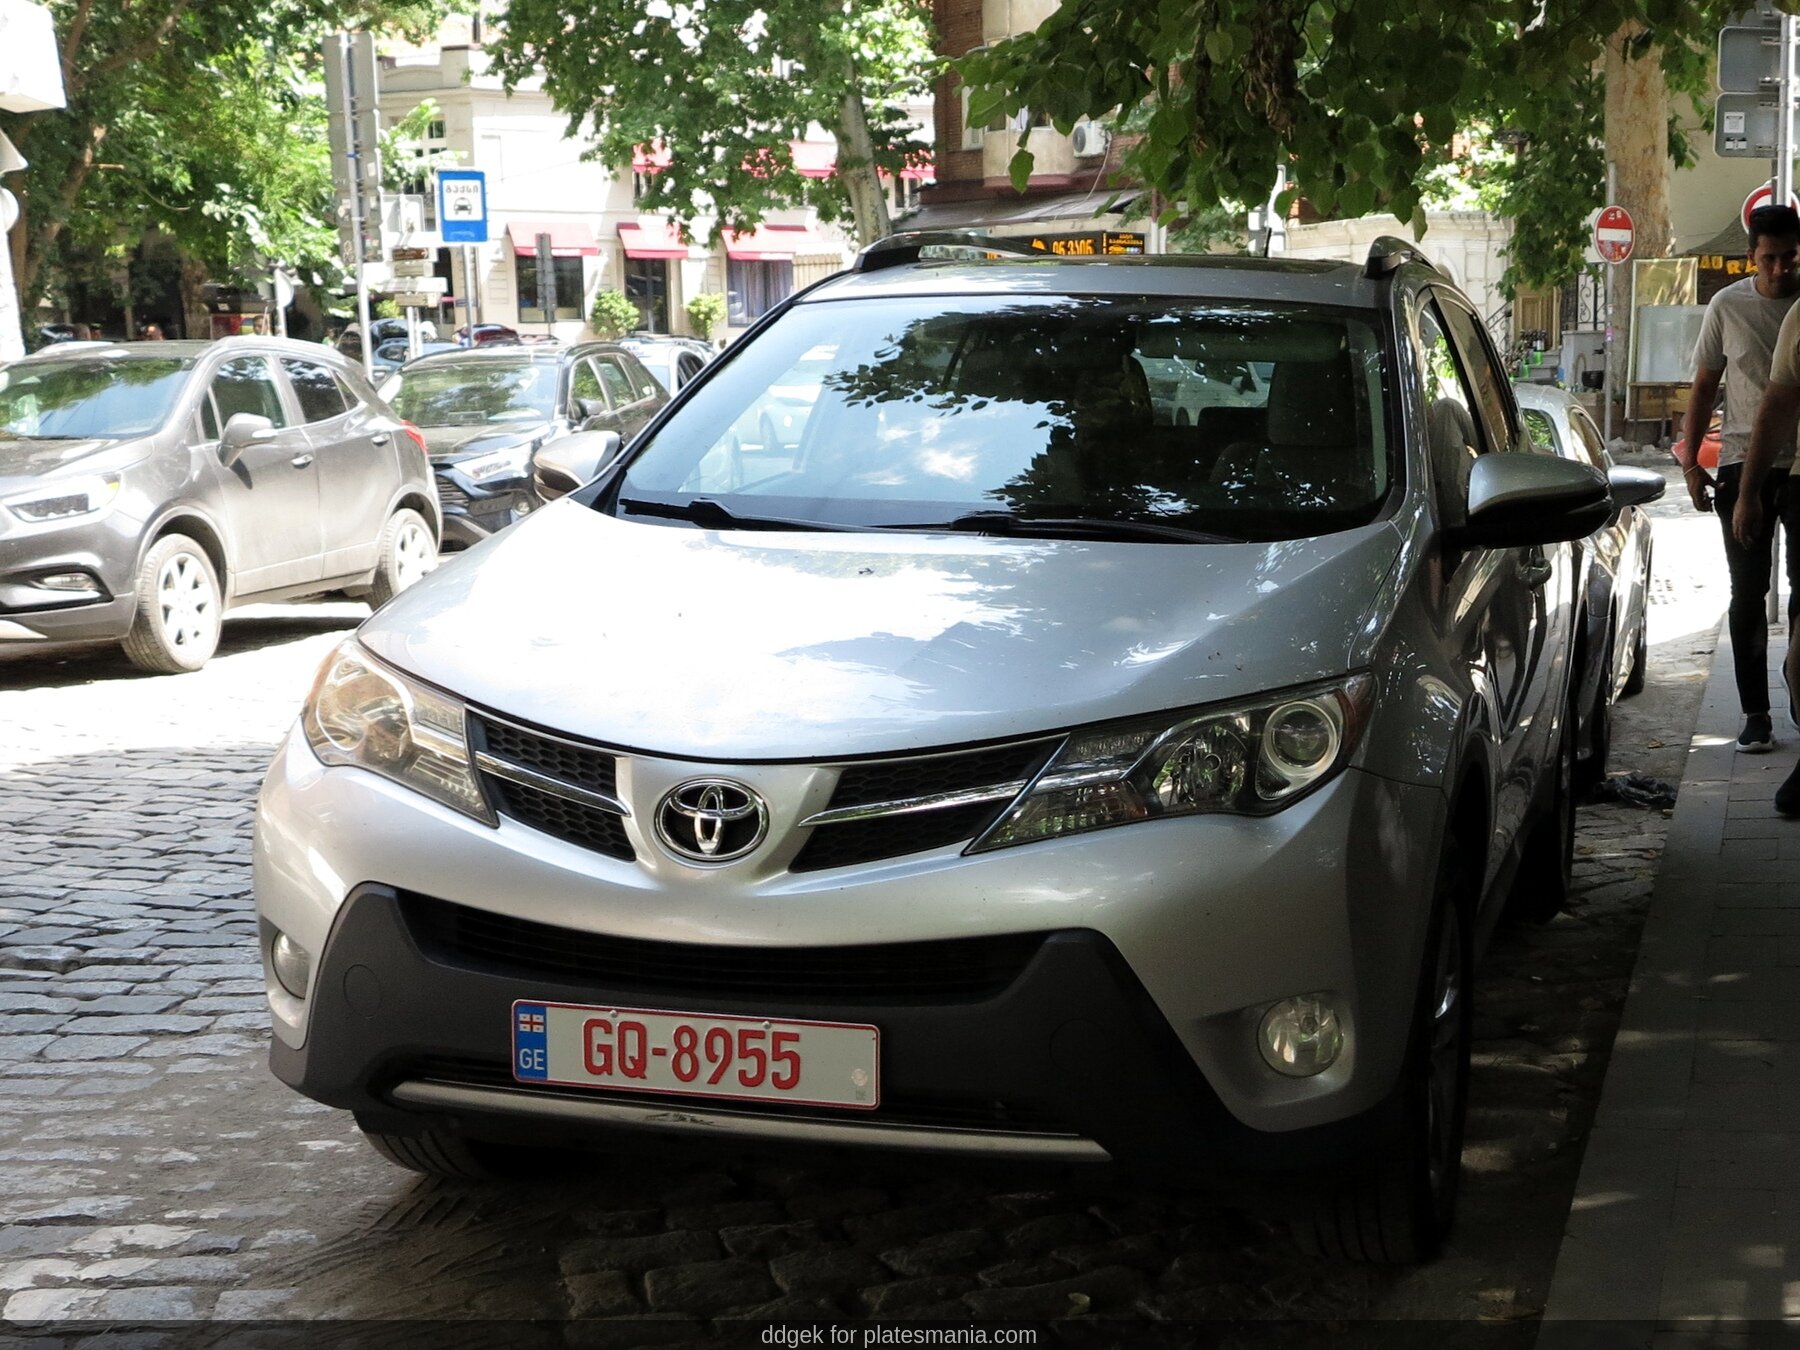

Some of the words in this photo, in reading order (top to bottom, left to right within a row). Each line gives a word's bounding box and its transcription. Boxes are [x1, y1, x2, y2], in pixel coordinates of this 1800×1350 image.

[445, 184, 479, 194] ტაქსი
[518, 1048, 545, 1072] GE
[582, 1017, 802, 1091] GQ-8955
